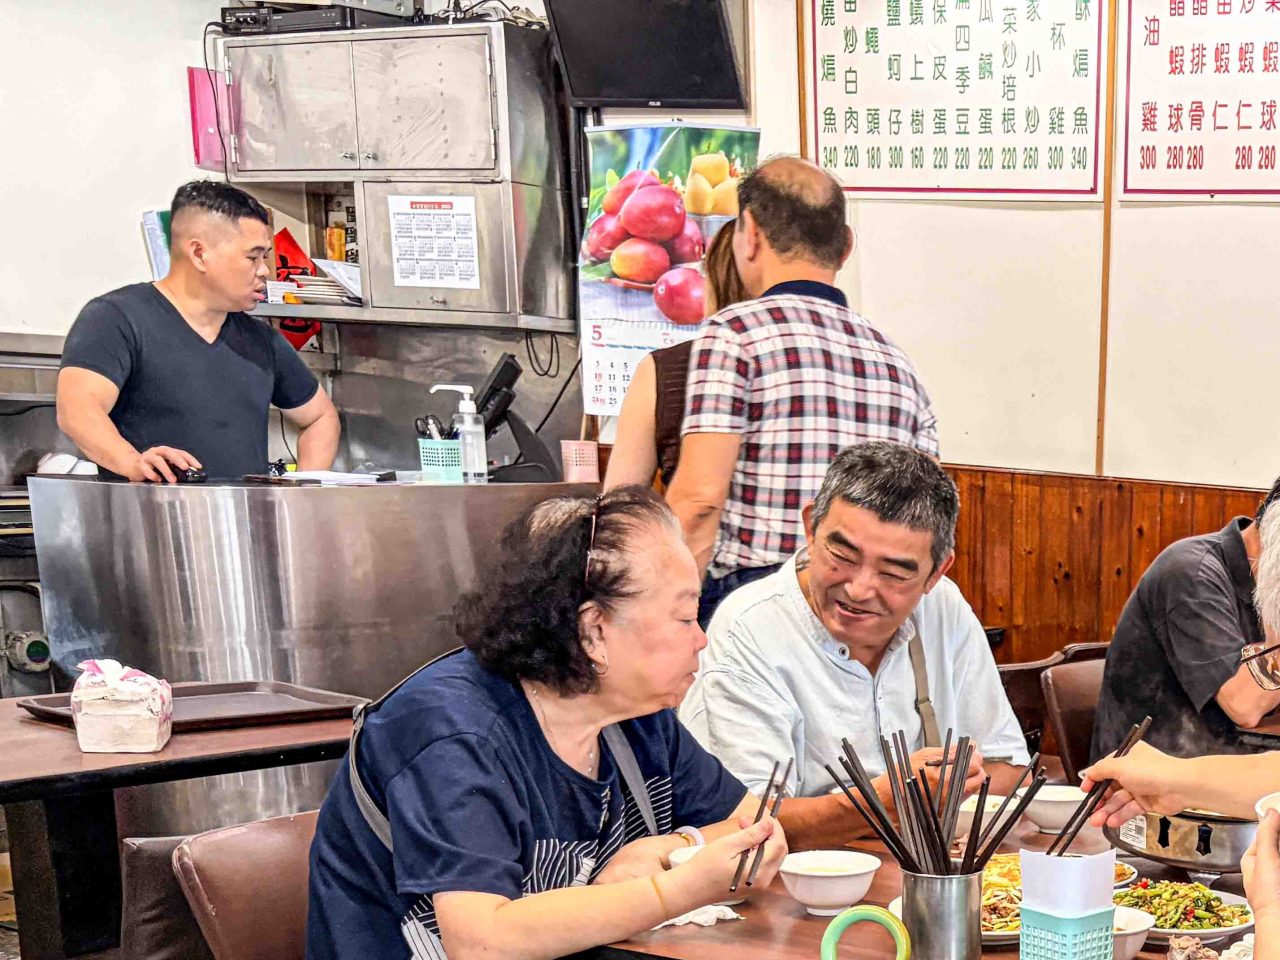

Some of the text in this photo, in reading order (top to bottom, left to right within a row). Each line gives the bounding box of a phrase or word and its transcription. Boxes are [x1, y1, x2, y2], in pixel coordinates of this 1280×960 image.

[823, 146, 838, 169] 340
[844, 145, 859, 169] 220
[866, 147, 881, 169] 180
[888, 146, 904, 169] 300
[910, 146, 925, 169] 160
[932, 147, 948, 169] 220
[954, 147, 970, 169] 220
[978, 147, 994, 169] 220
[1001, 147, 1017, 169] 220
[1022, 147, 1039, 169] 260
[1047, 147, 1064, 169] 300
[1071, 147, 1088, 169] 340
[1139, 145, 1157, 170] 300
[1166, 145, 1184, 170] 280
[1187, 145, 1204, 170] 280
[1235, 145, 1253, 170] 280
[1258, 145, 1276, 170] 280
[591, 325, 602, 341] 5
[594, 372, 603, 380] 10
[622, 374, 631, 382] 12
[594, 384, 603, 392] 17
